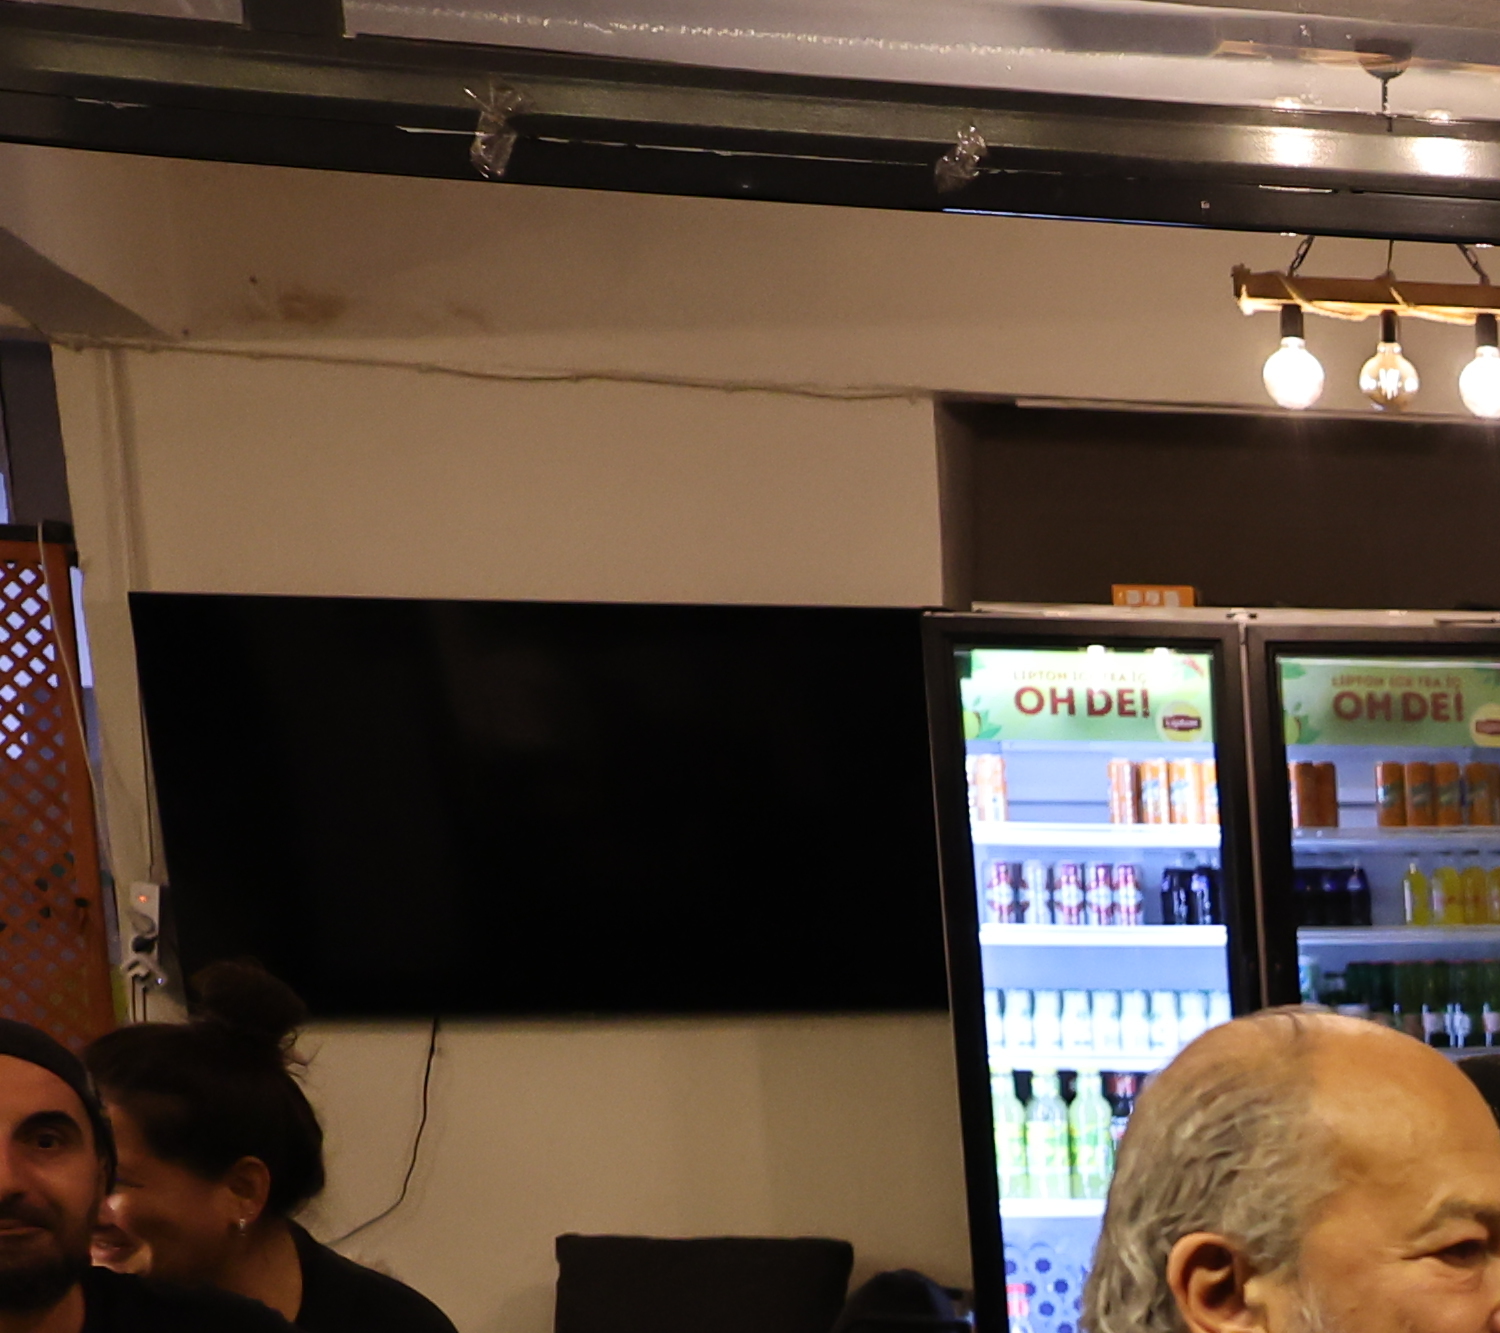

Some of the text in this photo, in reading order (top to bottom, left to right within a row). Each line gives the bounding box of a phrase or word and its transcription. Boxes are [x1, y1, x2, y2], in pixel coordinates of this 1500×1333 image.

[1014, 686, 1150, 718] OH DE!
[1332, 690, 1465, 722] OH DE!
